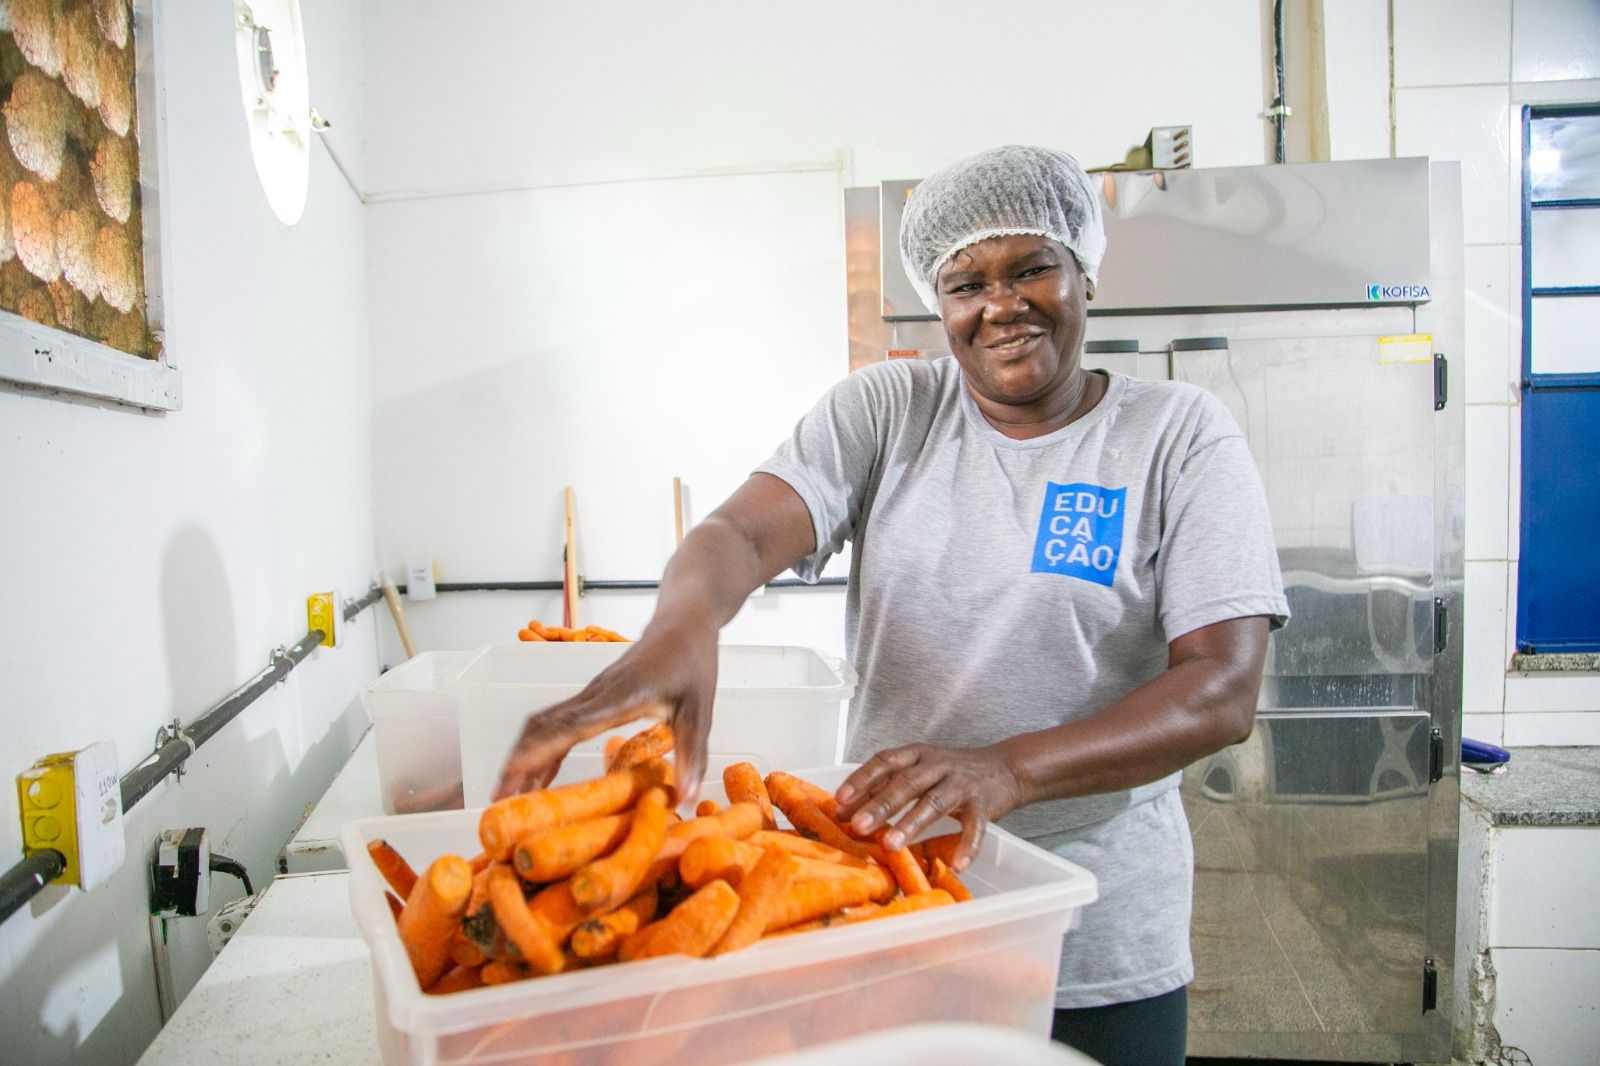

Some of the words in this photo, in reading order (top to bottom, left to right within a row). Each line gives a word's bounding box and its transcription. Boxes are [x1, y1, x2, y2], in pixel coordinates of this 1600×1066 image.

[1383, 286, 1430, 297] KOFISA
[1054, 492, 1119, 518] EDU
[1049, 515, 1093, 541] CA
[1044, 537, 1114, 571] ÇÃO
